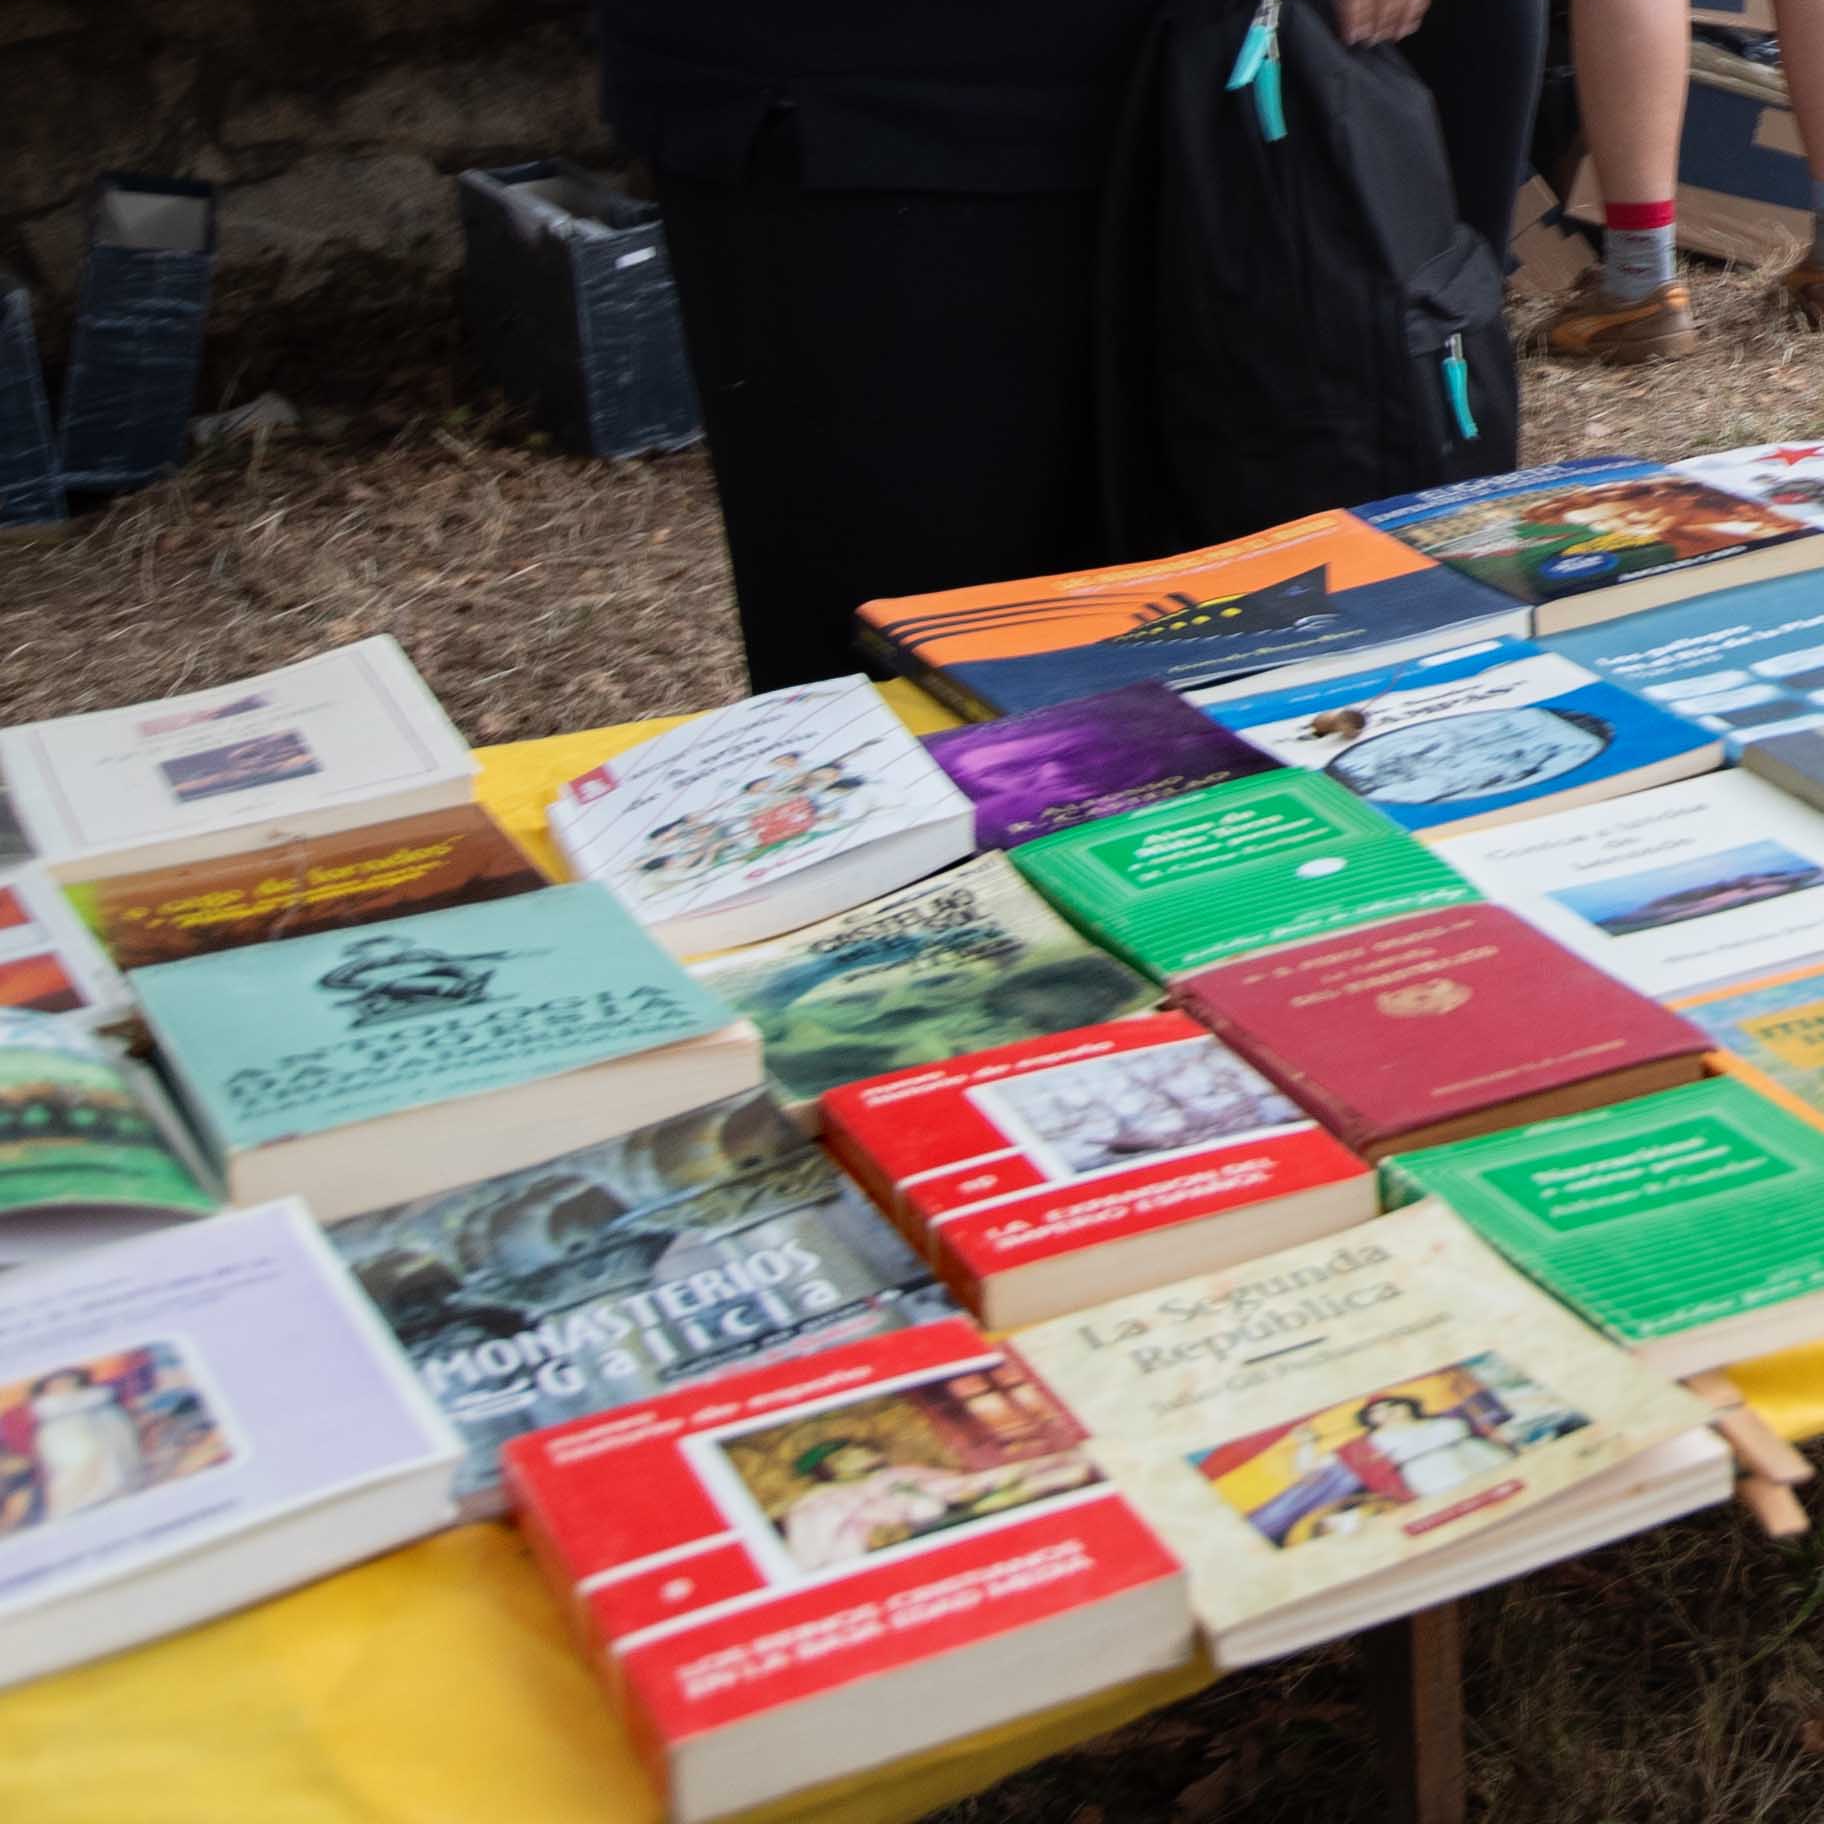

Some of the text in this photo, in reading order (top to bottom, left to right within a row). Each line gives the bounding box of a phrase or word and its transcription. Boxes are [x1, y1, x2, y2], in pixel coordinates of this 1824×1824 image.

[422, 1238, 823, 1398] MONASTERIOS
[537, 1279, 843, 1398] Galicia
[1078, 1239, 1393, 1354] La Segunda
[1131, 1277, 1404, 1377] República
